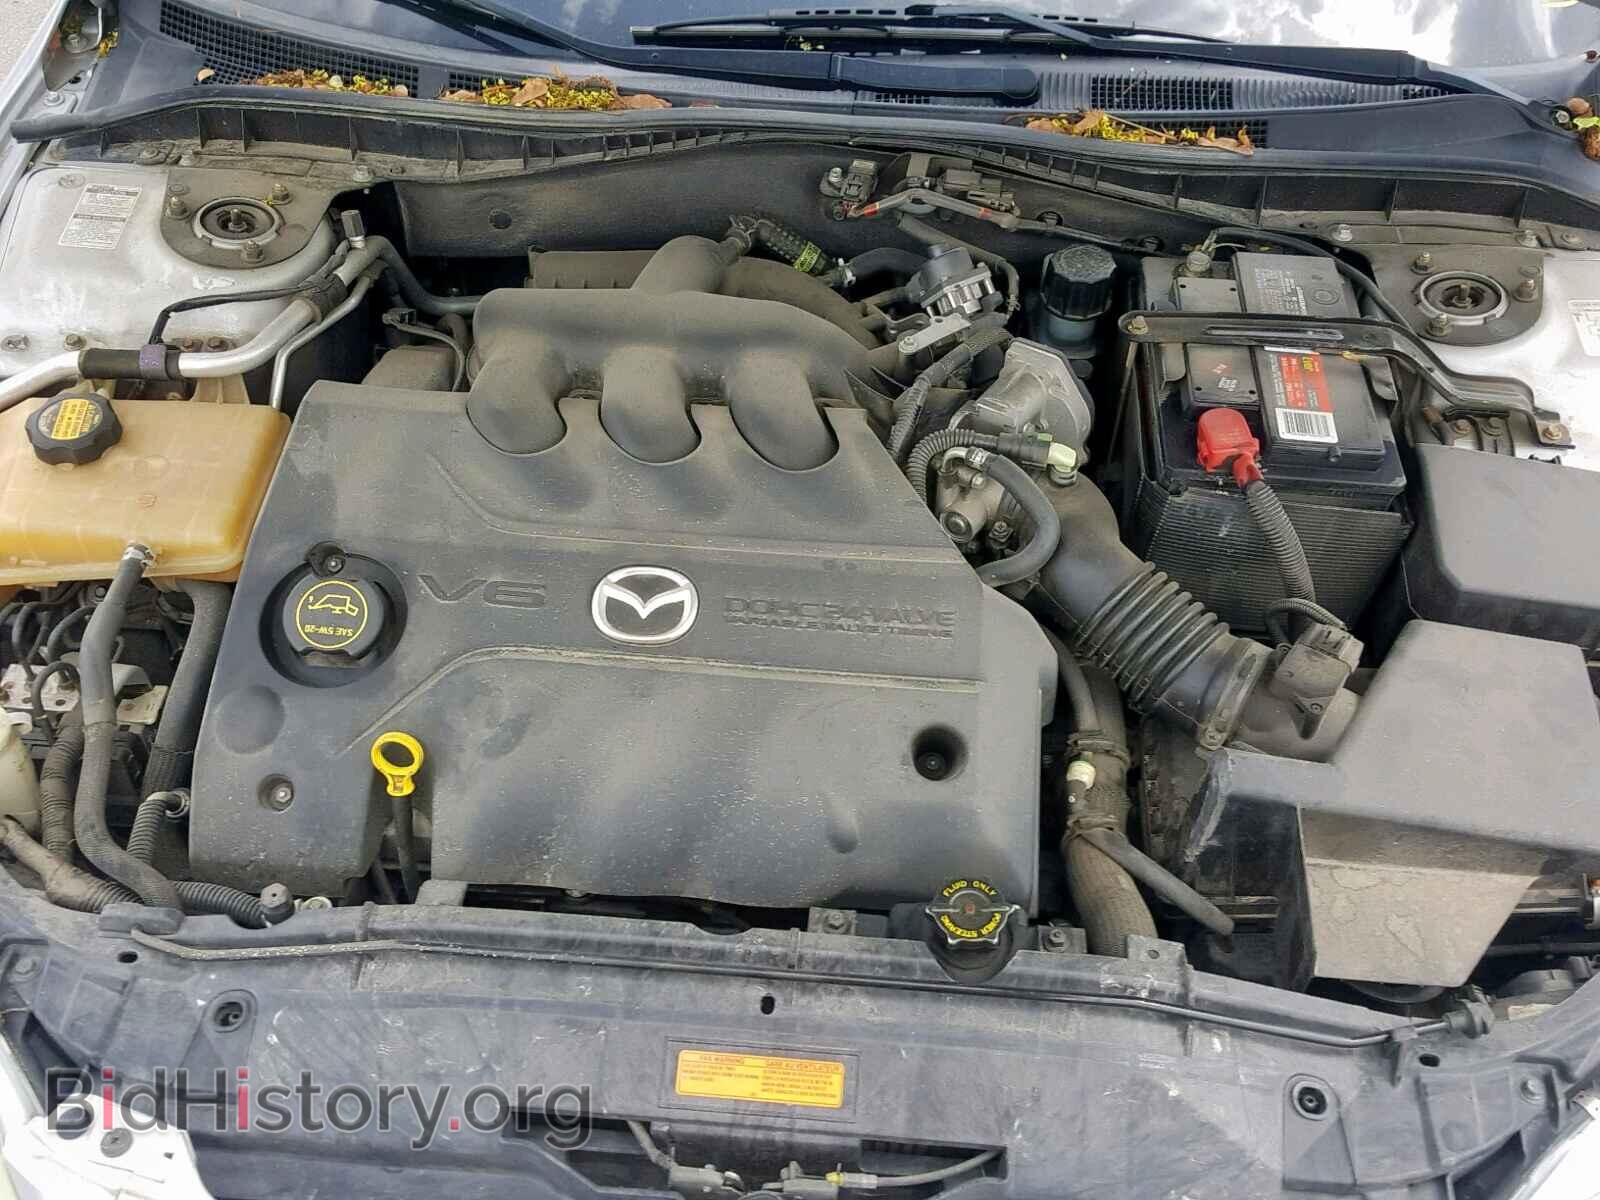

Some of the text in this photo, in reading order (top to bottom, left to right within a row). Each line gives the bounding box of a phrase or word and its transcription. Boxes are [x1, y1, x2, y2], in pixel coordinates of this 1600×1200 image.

[417, 574, 546, 609] V6
[304, 624, 354, 638] SAE 5W-20
[942, 880, 998, 897] FLUID ONLY
[940, 912, 1002, 938] POWER STEERING
